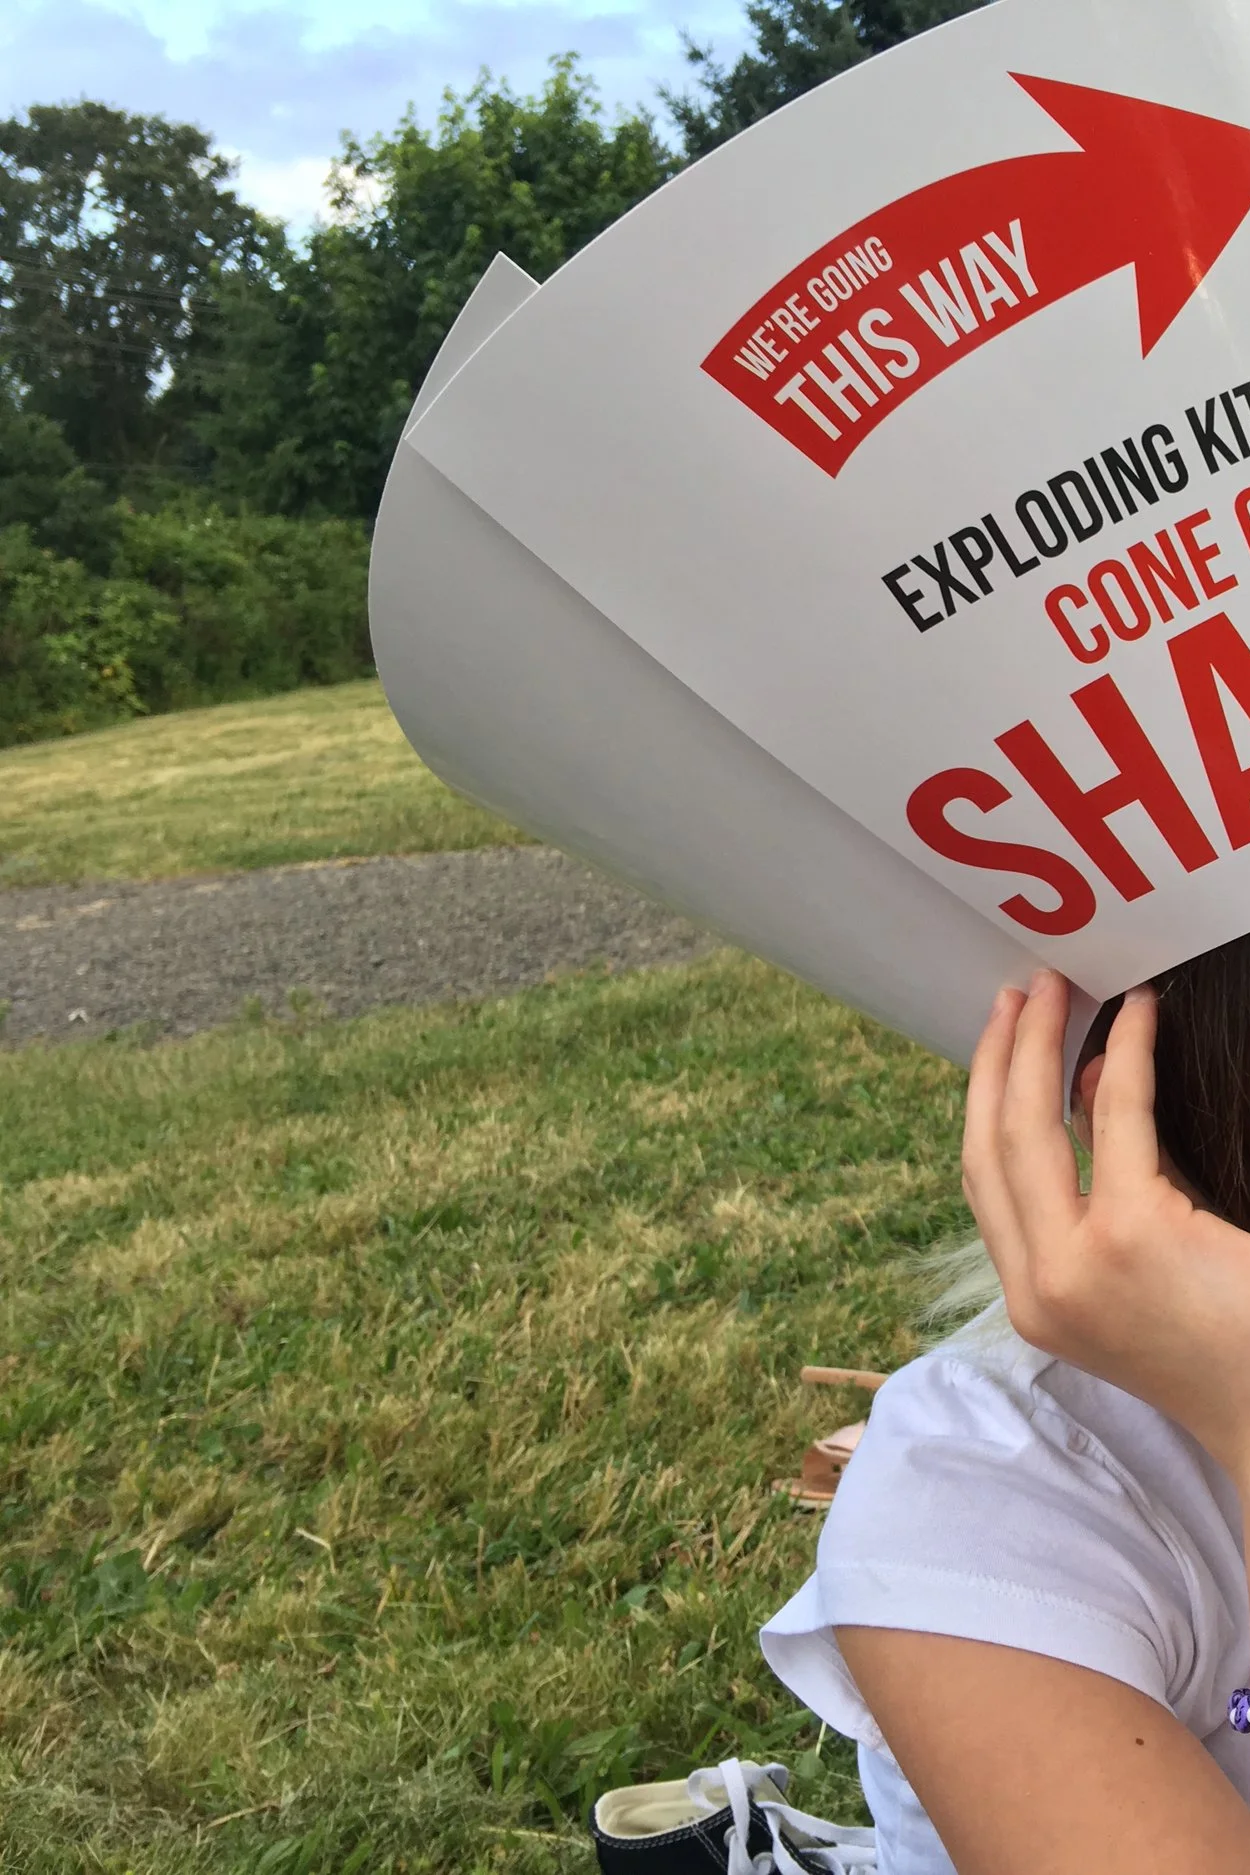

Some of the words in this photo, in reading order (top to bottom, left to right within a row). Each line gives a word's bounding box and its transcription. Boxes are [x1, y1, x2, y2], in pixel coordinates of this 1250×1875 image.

[733, 293, 821, 382] WE'RE
[806, 235, 894, 313] GOING
[774, 308, 921, 442] THIS
[899, 218, 1040, 348] WAY
[881, 423, 1188, 633] EXPLODING
[1044, 508, 1238, 664] CONE
